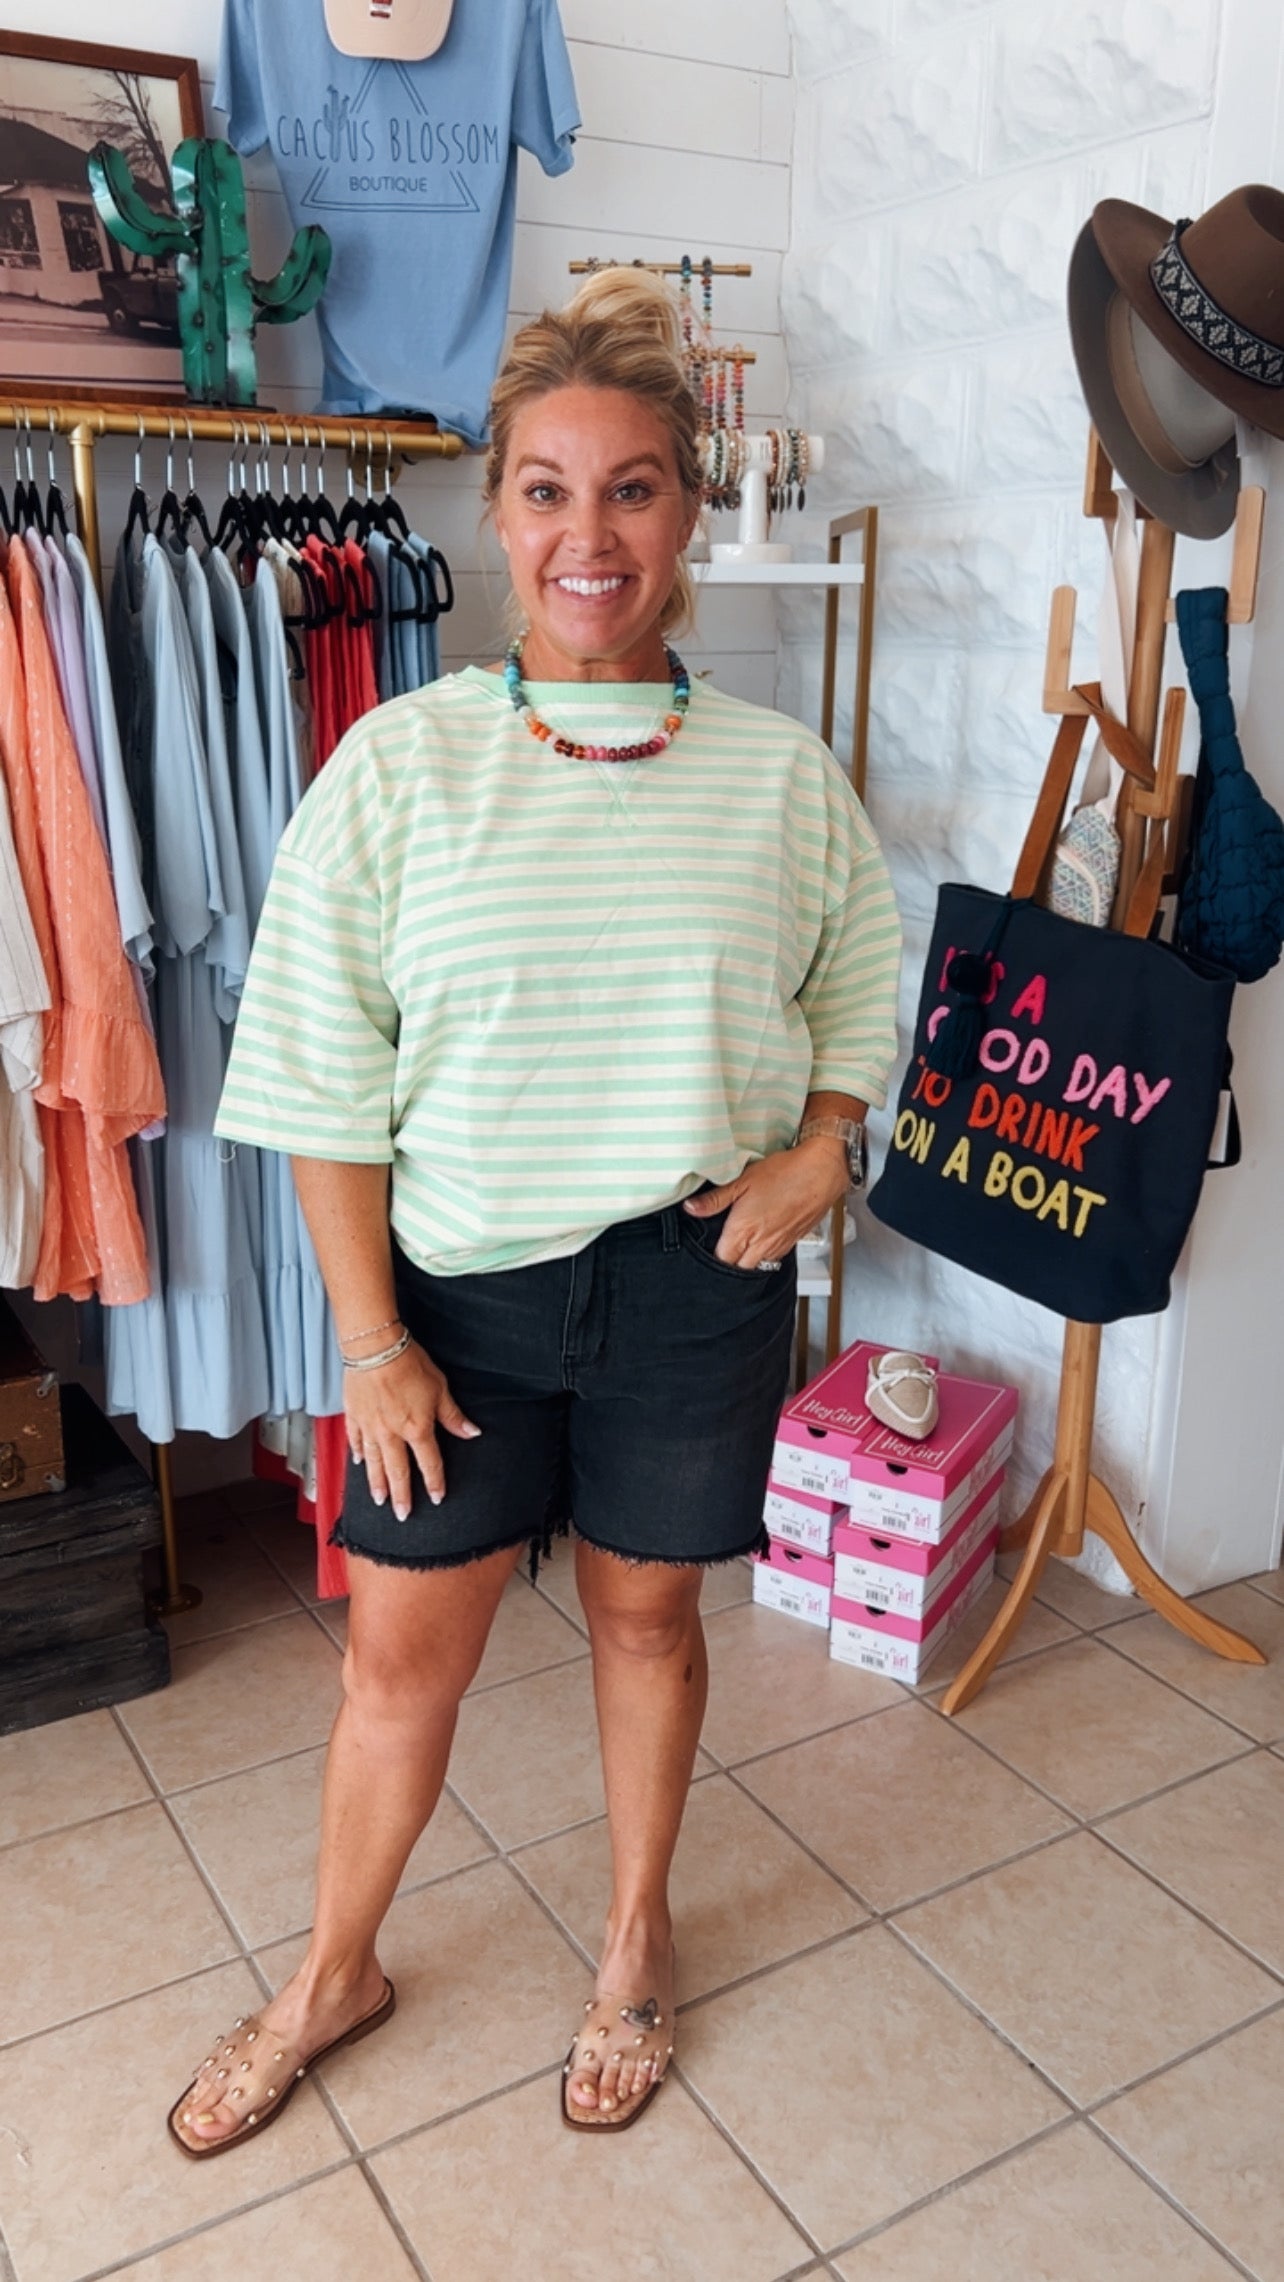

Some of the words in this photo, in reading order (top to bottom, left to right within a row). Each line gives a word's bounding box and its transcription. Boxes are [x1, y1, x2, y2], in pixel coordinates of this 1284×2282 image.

[277, 108, 375, 163] CACTUS
[389, 117, 500, 165] BLOSSOM
[349, 176, 428, 193] BOUTIQUE
[1010, 974, 1047, 1025] A
[1062, 1053, 1172, 1124] DAY
[967, 1083, 1100, 1172] DRINK
[894, 1109, 936, 1164] ON
[941, 1136, 971, 1183] A
[983, 1151, 1107, 1238] BOAT
